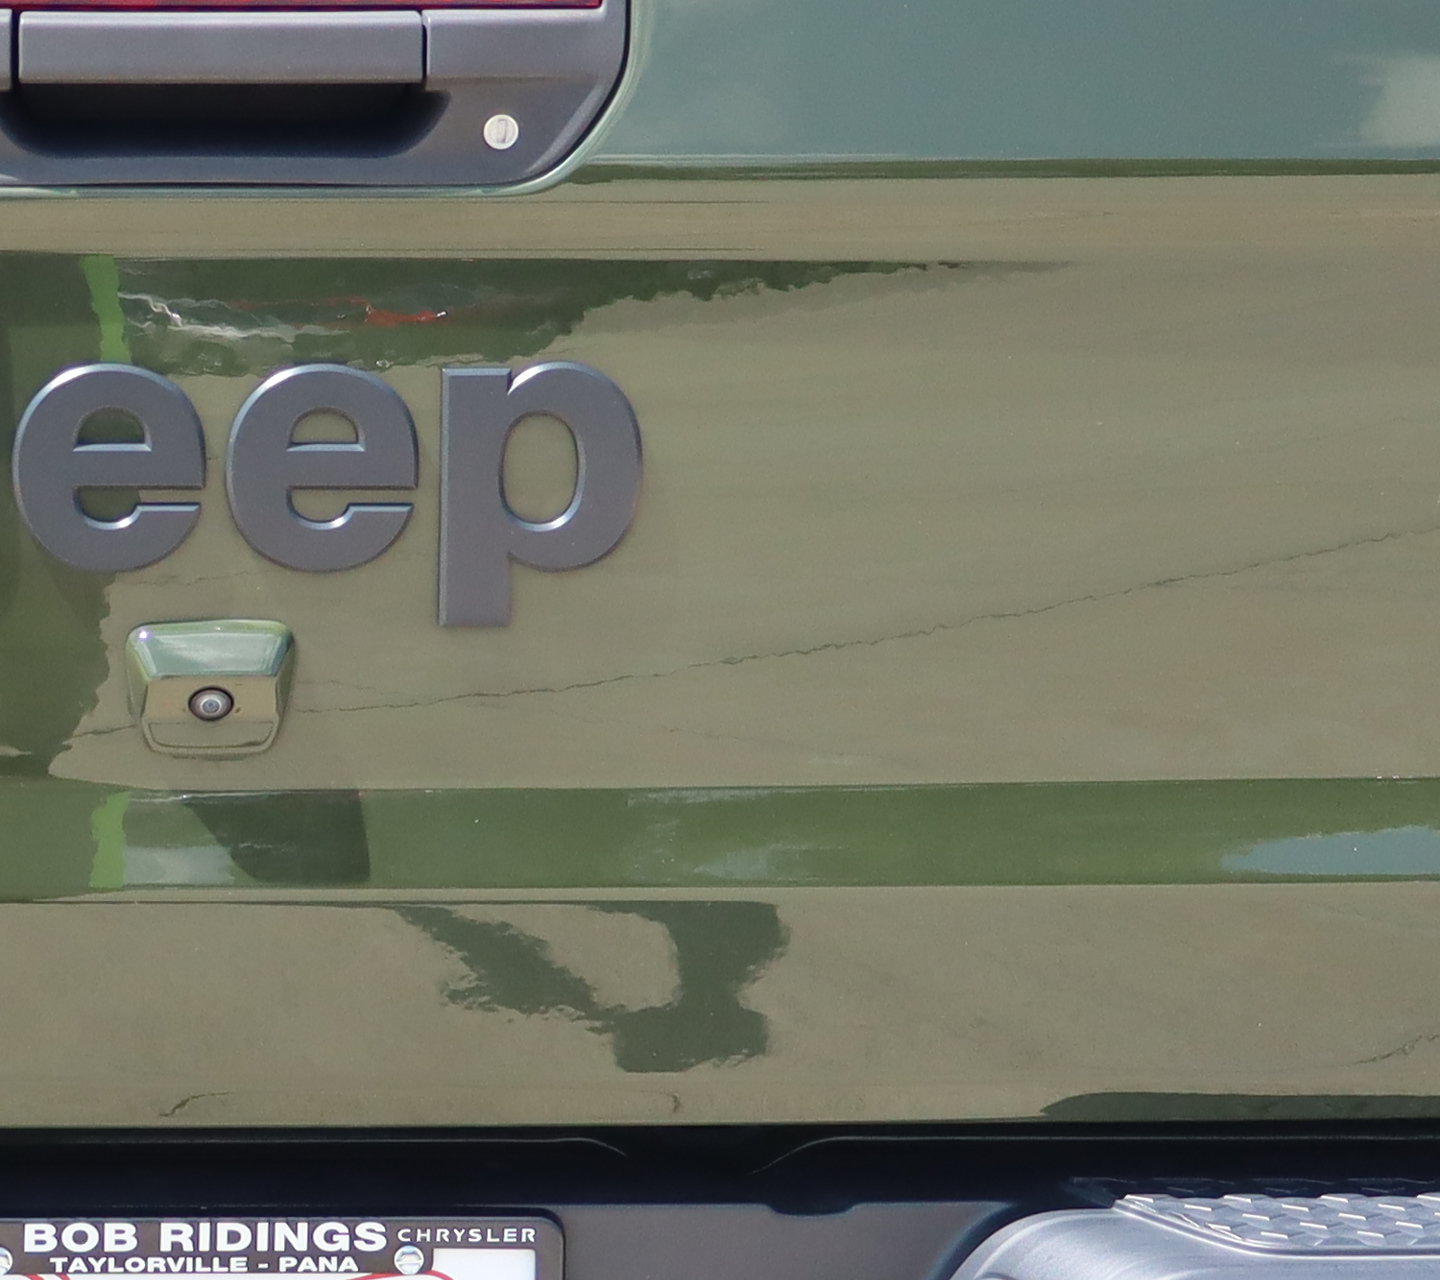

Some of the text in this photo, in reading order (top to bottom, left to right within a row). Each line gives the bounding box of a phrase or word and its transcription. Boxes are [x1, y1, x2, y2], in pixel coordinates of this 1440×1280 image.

[24, 1221, 388, 1253] BOB RIDINGS
[397, 1228, 536, 1243] CHRYSLER
[50, 1257, 248, 1273] TAYLORVILLE
[279, 1256, 359, 1272] PANA
